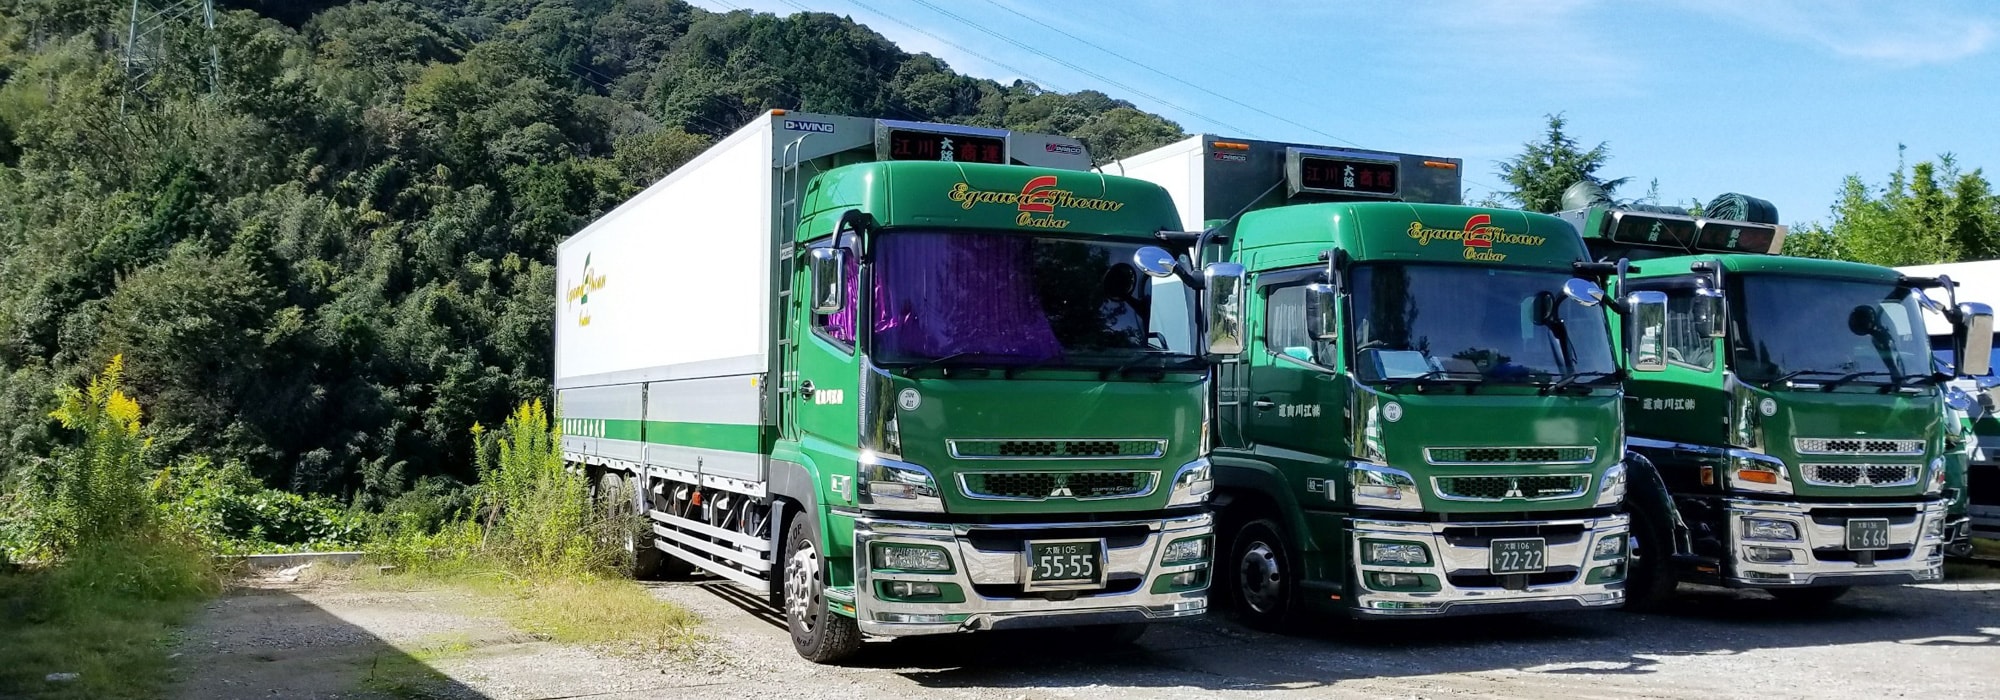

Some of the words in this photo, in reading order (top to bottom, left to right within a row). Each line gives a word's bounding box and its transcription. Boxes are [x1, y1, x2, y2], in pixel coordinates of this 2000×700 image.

[948, 183, 1035, 210] Egawa
[1015, 211, 1070, 229] Osaka
[1407, 221, 1473, 246] Egawa
[1463, 246, 1507, 262] Osaka
[1062, 545, 1077, 554] 105
[1517, 542, 1530, 550] 106
[1041, 554, 1093, 578] 55-55
[1501, 550, 1542, 570] 22-22
